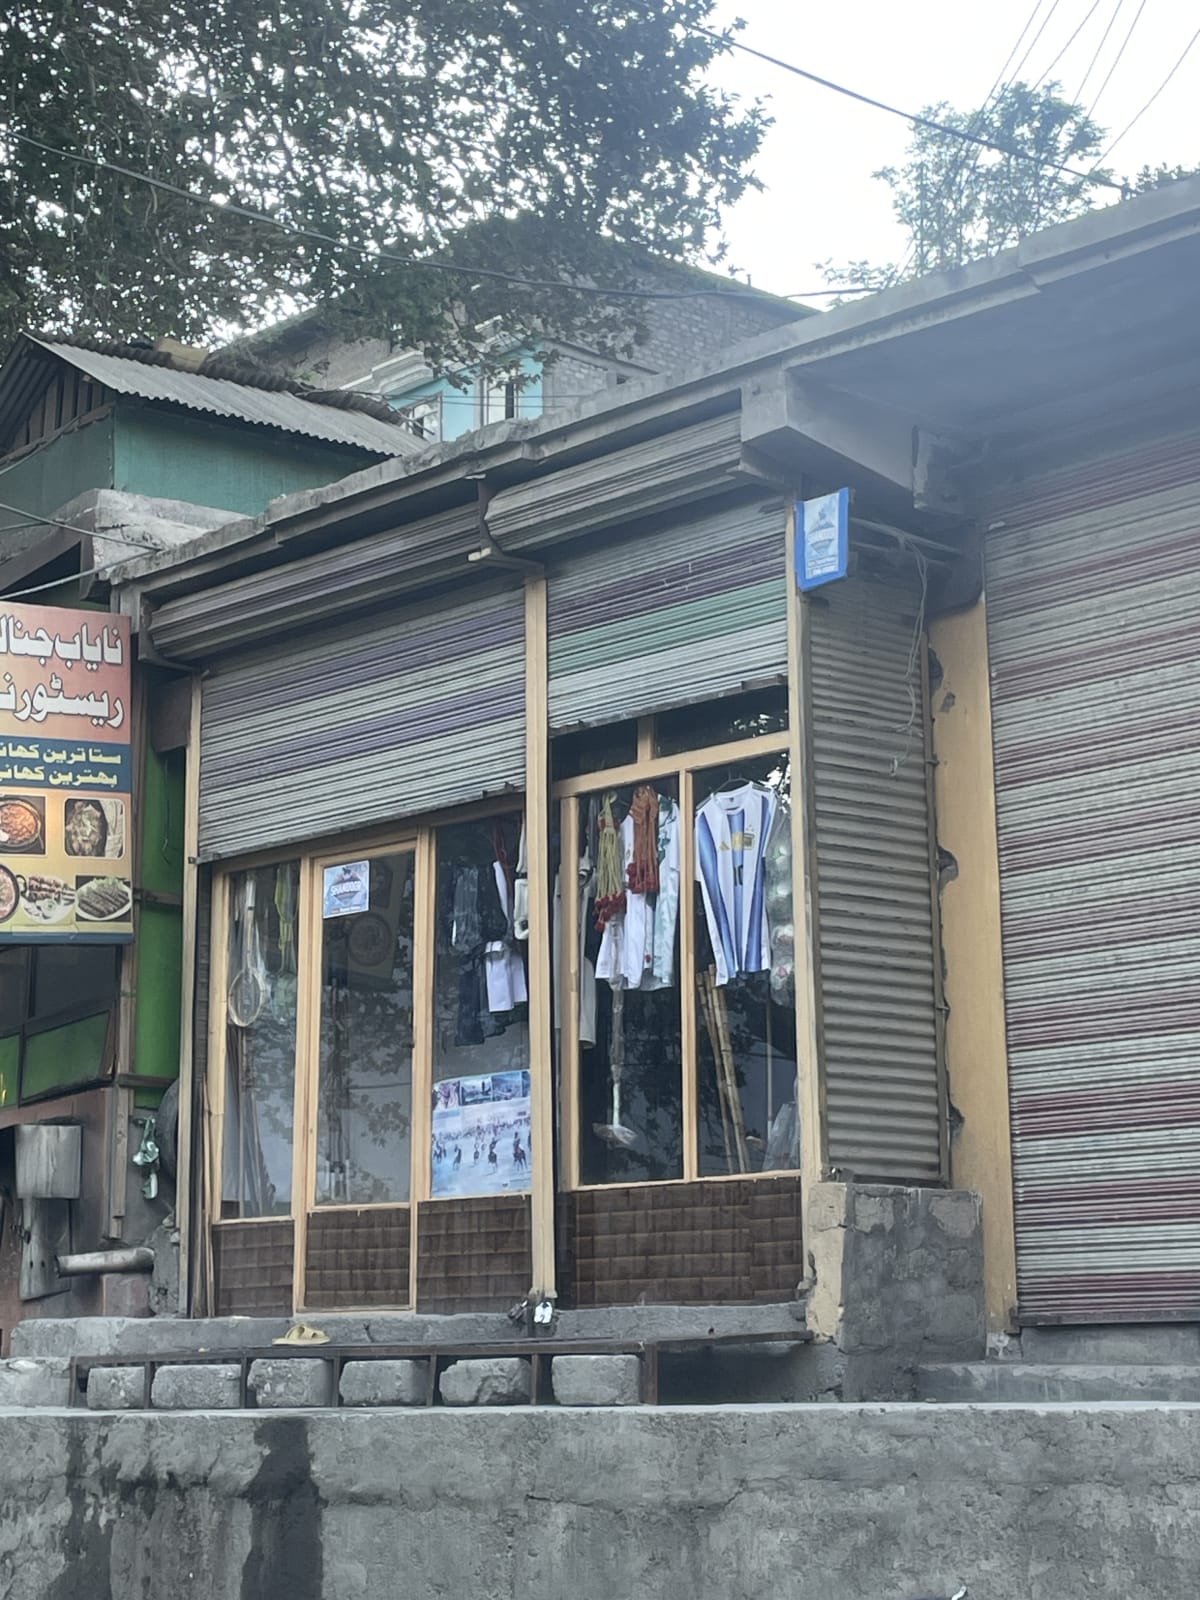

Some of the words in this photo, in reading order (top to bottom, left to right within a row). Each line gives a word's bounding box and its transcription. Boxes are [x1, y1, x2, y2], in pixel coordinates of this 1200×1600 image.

[0, 614, 54, 667] جنال
[54, 622, 123, 671] نایاب
[0, 672, 124, 729] ریسٹورن
[0, 742, 40, 759] کھان
[0, 764, 45, 781] کھان
